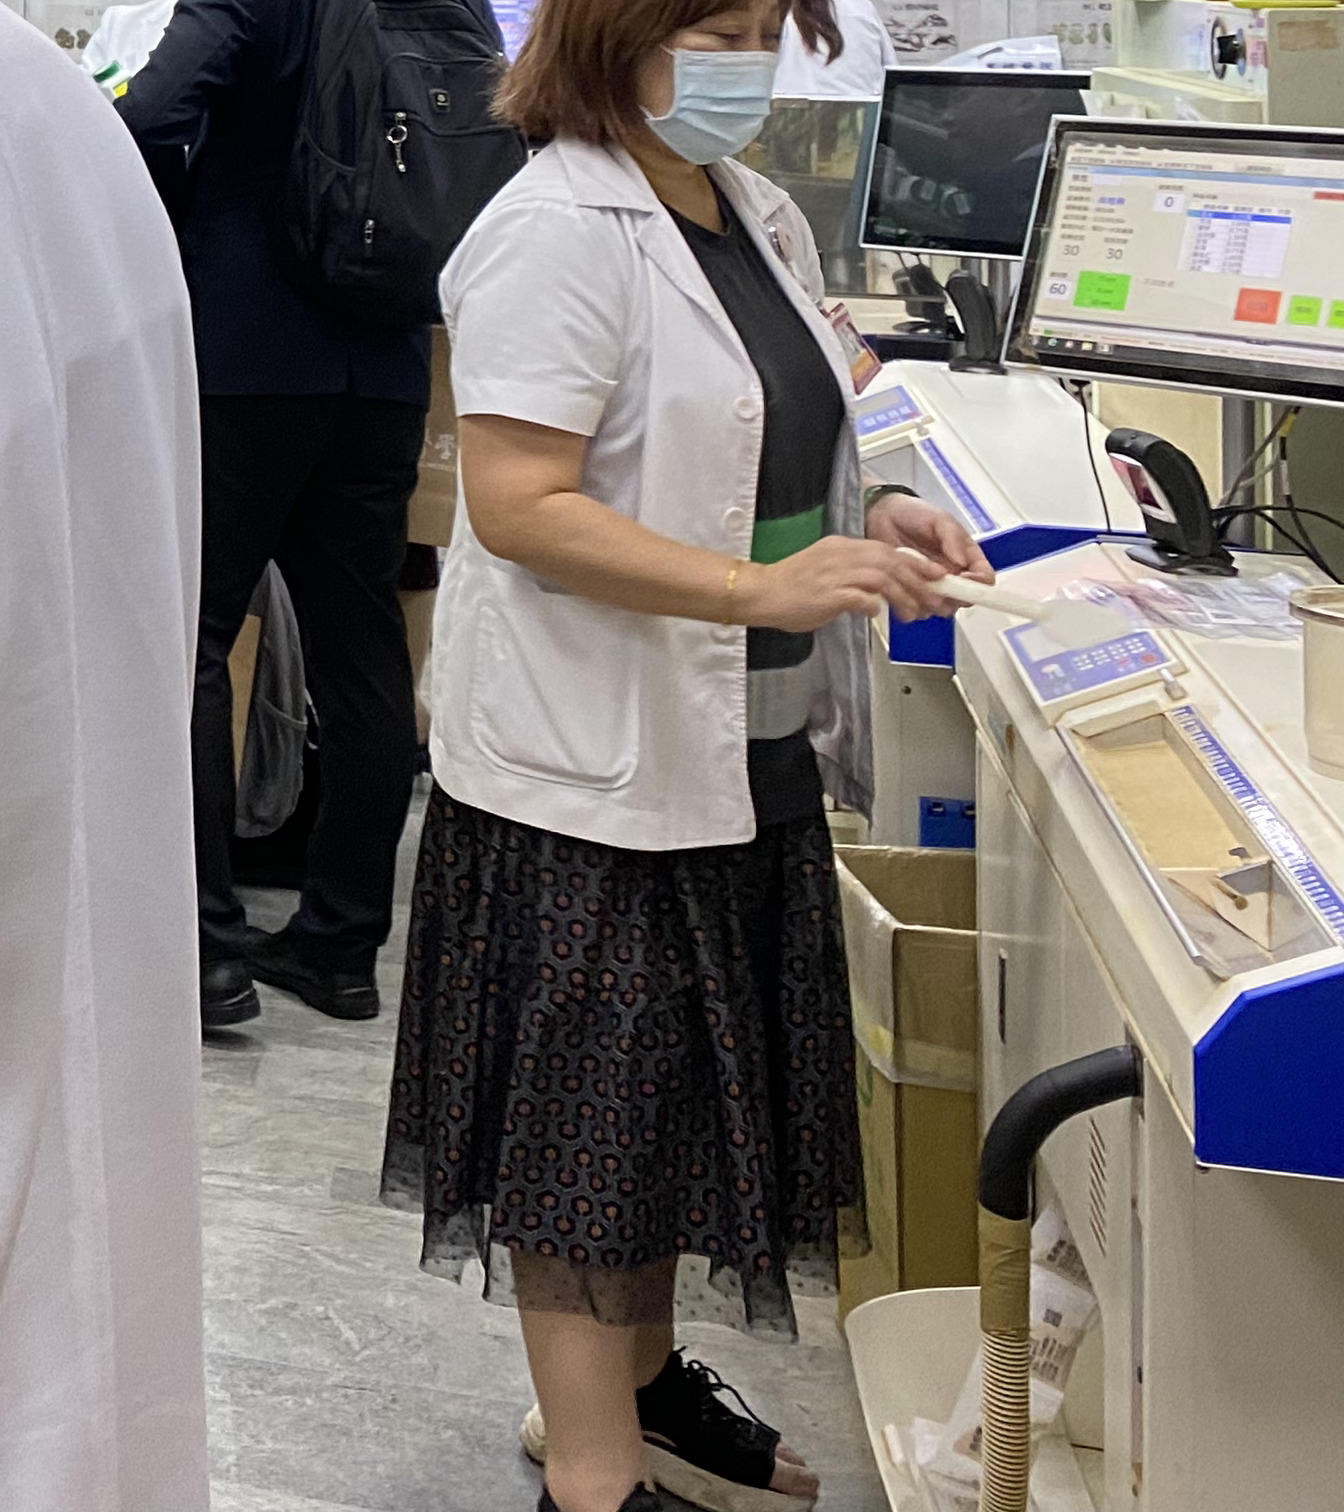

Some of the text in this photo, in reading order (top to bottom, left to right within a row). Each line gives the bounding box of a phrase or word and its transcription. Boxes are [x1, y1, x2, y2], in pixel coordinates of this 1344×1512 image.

[1165, 197, 1173, 207] 0
[1063, 245, 1123, 260] 30 30
[1050, 284, 1066, 295] 60
